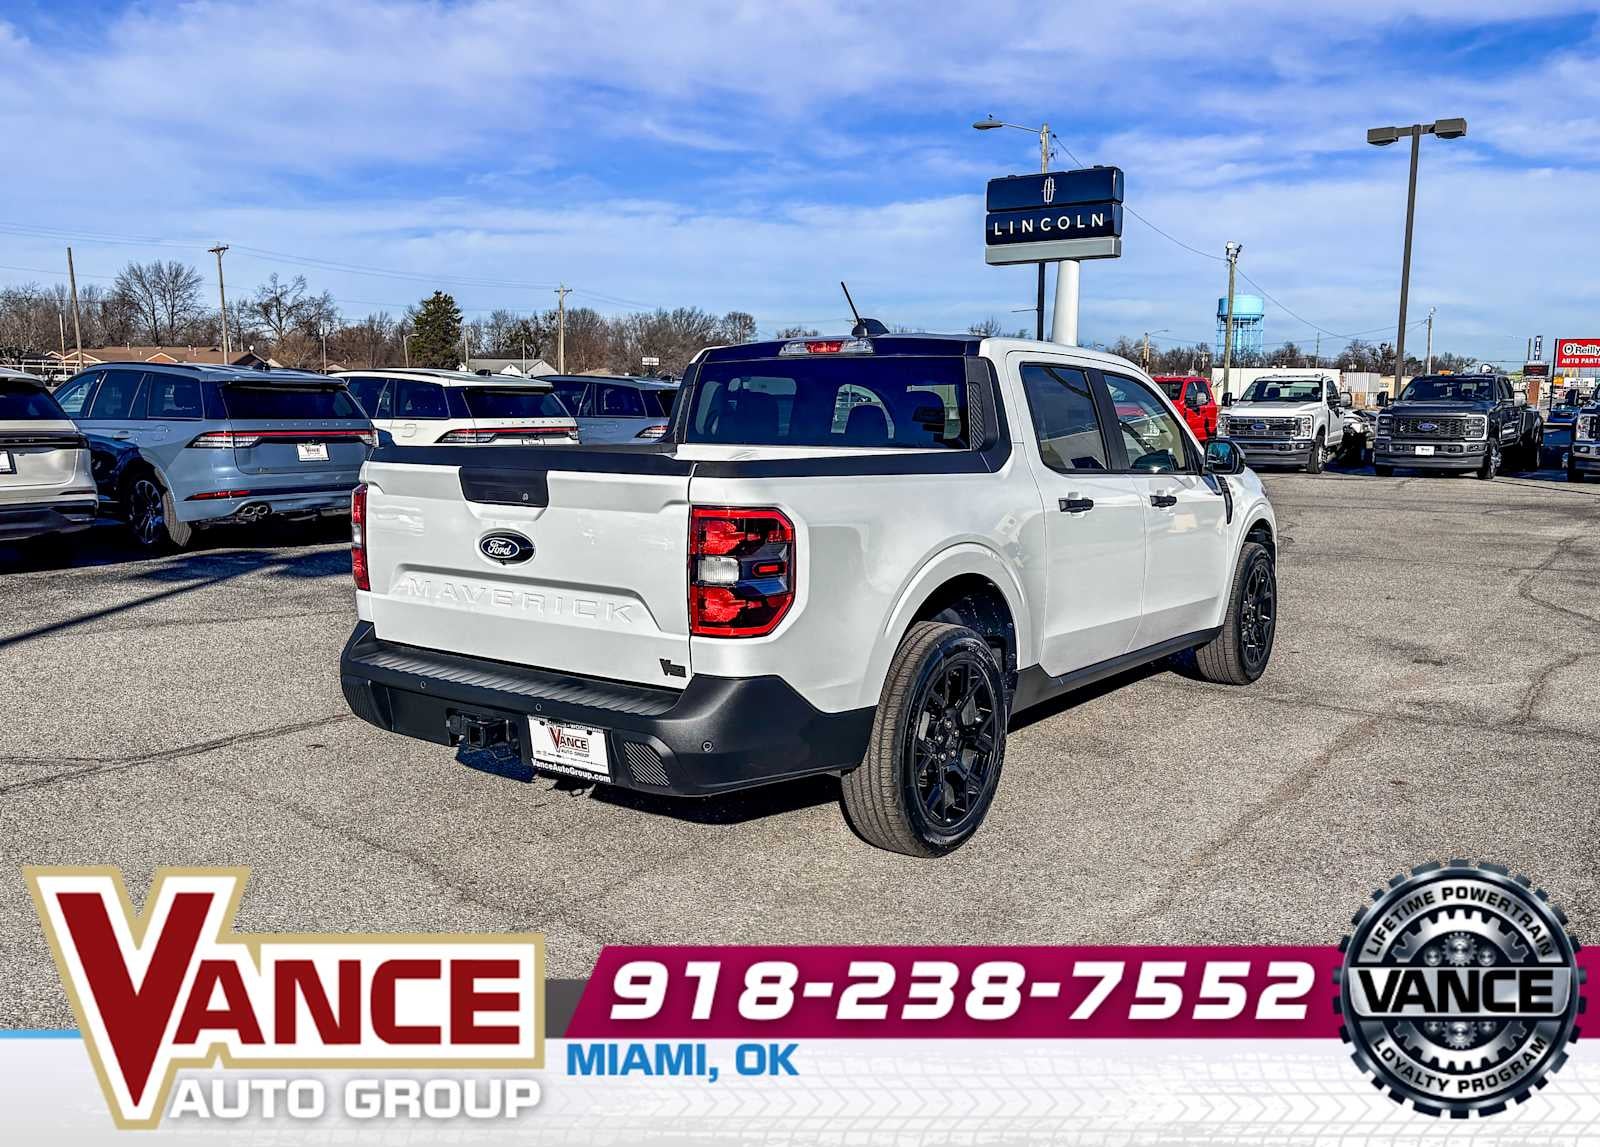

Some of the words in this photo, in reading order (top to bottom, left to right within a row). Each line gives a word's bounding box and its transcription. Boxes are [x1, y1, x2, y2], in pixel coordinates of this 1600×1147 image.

[994, 213, 1104, 236] LINCOLN
[1563, 343, 1600, 356] O'Reilly
[488, 540, 512, 556] Ford
[406, 576, 633, 624] MAVERICK
[549, 726, 588, 750] VANCE
[531, 758, 612, 783] VanceAutoGroup.com
